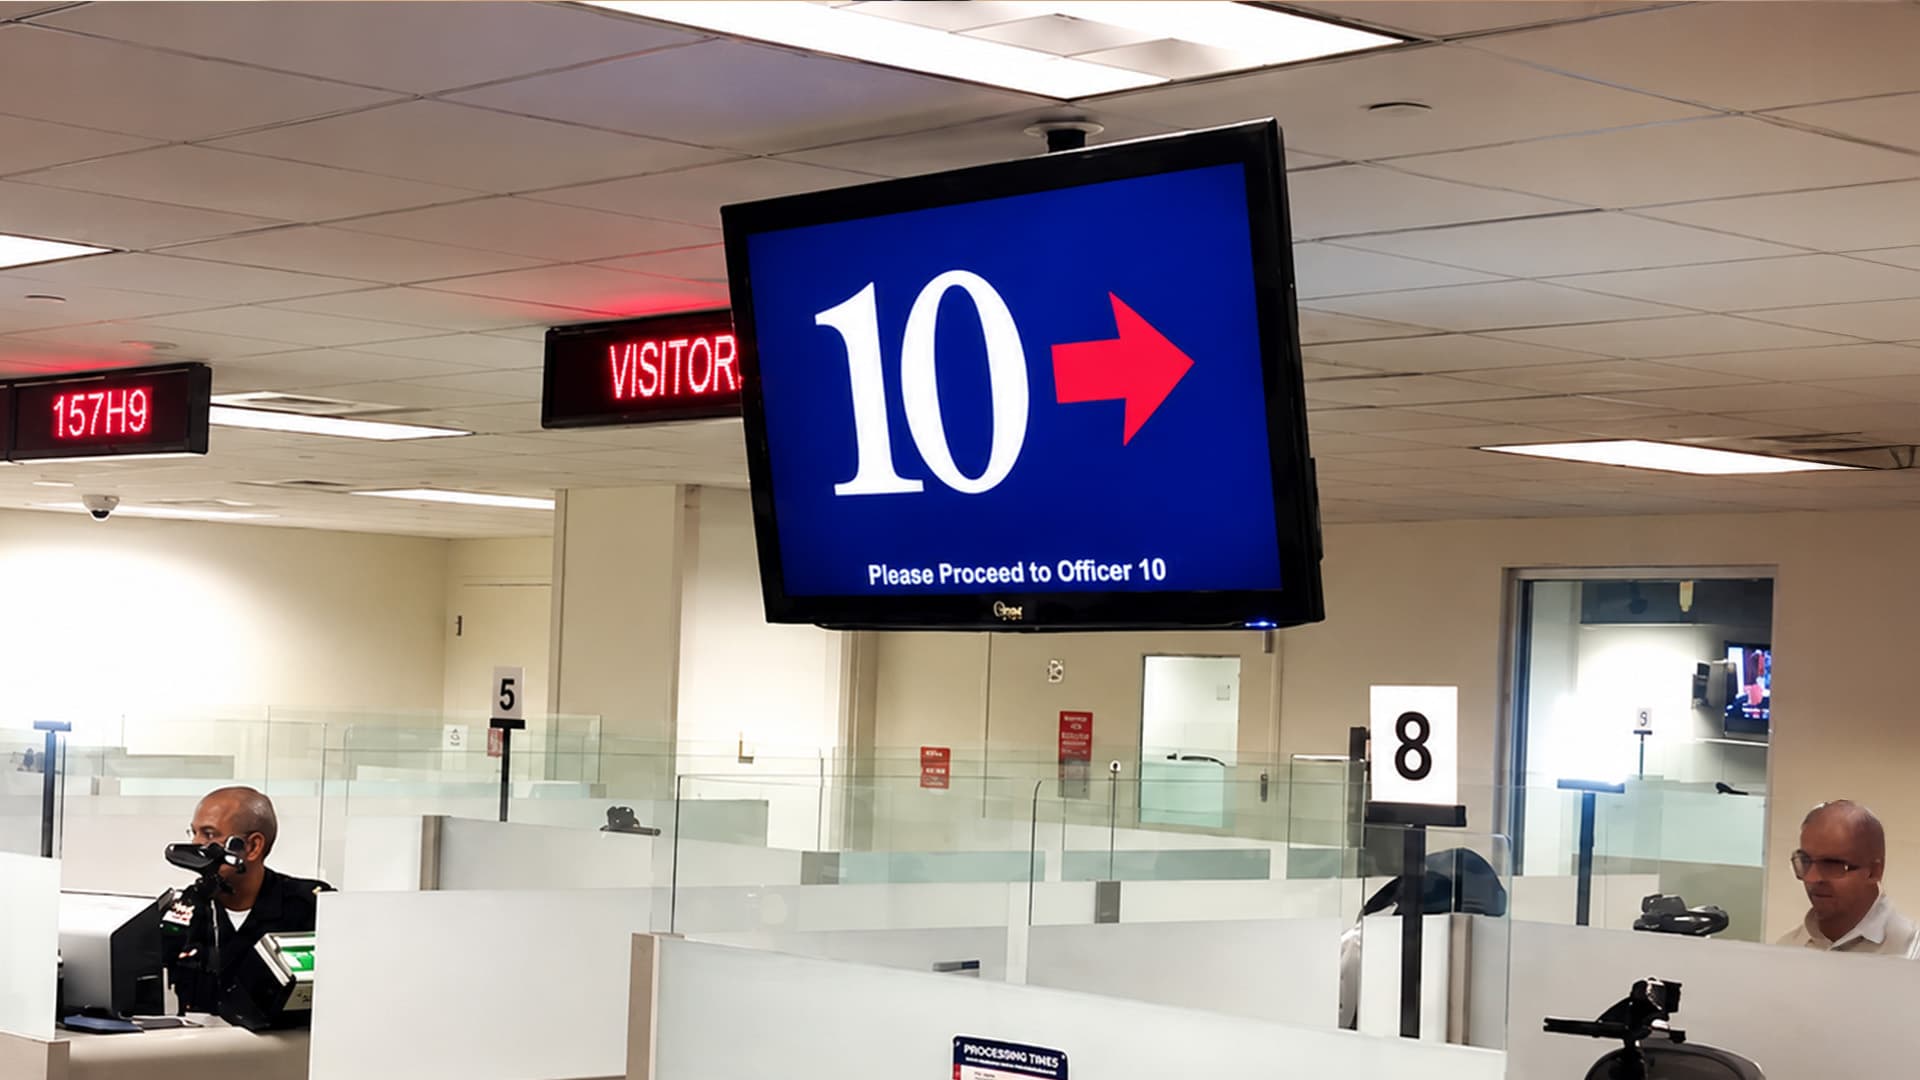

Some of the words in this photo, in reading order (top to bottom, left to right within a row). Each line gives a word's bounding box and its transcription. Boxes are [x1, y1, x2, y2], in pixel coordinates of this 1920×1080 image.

[610, 335, 743, 399] VISITOR
[814, 269, 1030, 496] 10
[53, 388, 147, 437] 157H9
[868, 563, 935, 586] Please
[938, 561, 1025, 585] Proceed
[1028, 561, 1052, 583] to
[1057, 558, 1133, 583] Officer
[1138, 557, 1167, 581] 10
[499, 678, 515, 711] 5
[1394, 711, 1432, 781] 8
[963, 1043, 1028, 1063] PROCESSING
